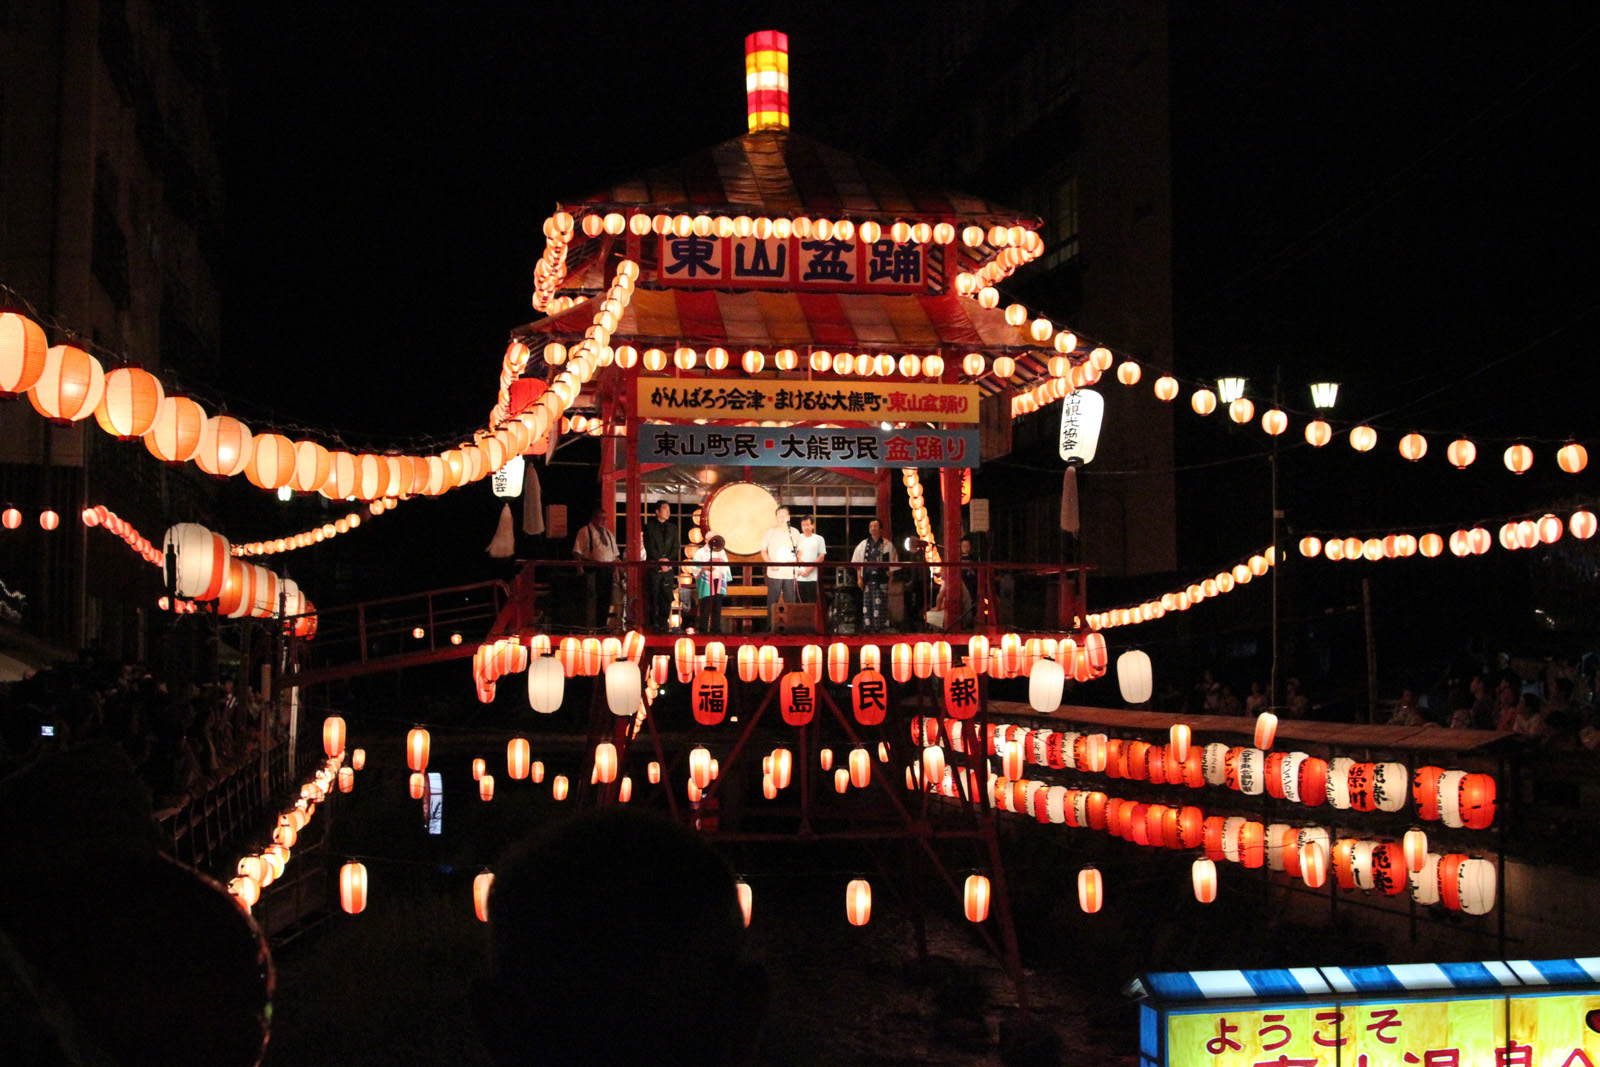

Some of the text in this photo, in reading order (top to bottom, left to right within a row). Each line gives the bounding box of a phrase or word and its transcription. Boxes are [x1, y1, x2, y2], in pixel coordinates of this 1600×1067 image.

[665, 234, 921, 283] 東山盆踊
[1206, 1009, 1402, 1055] ようこそ
